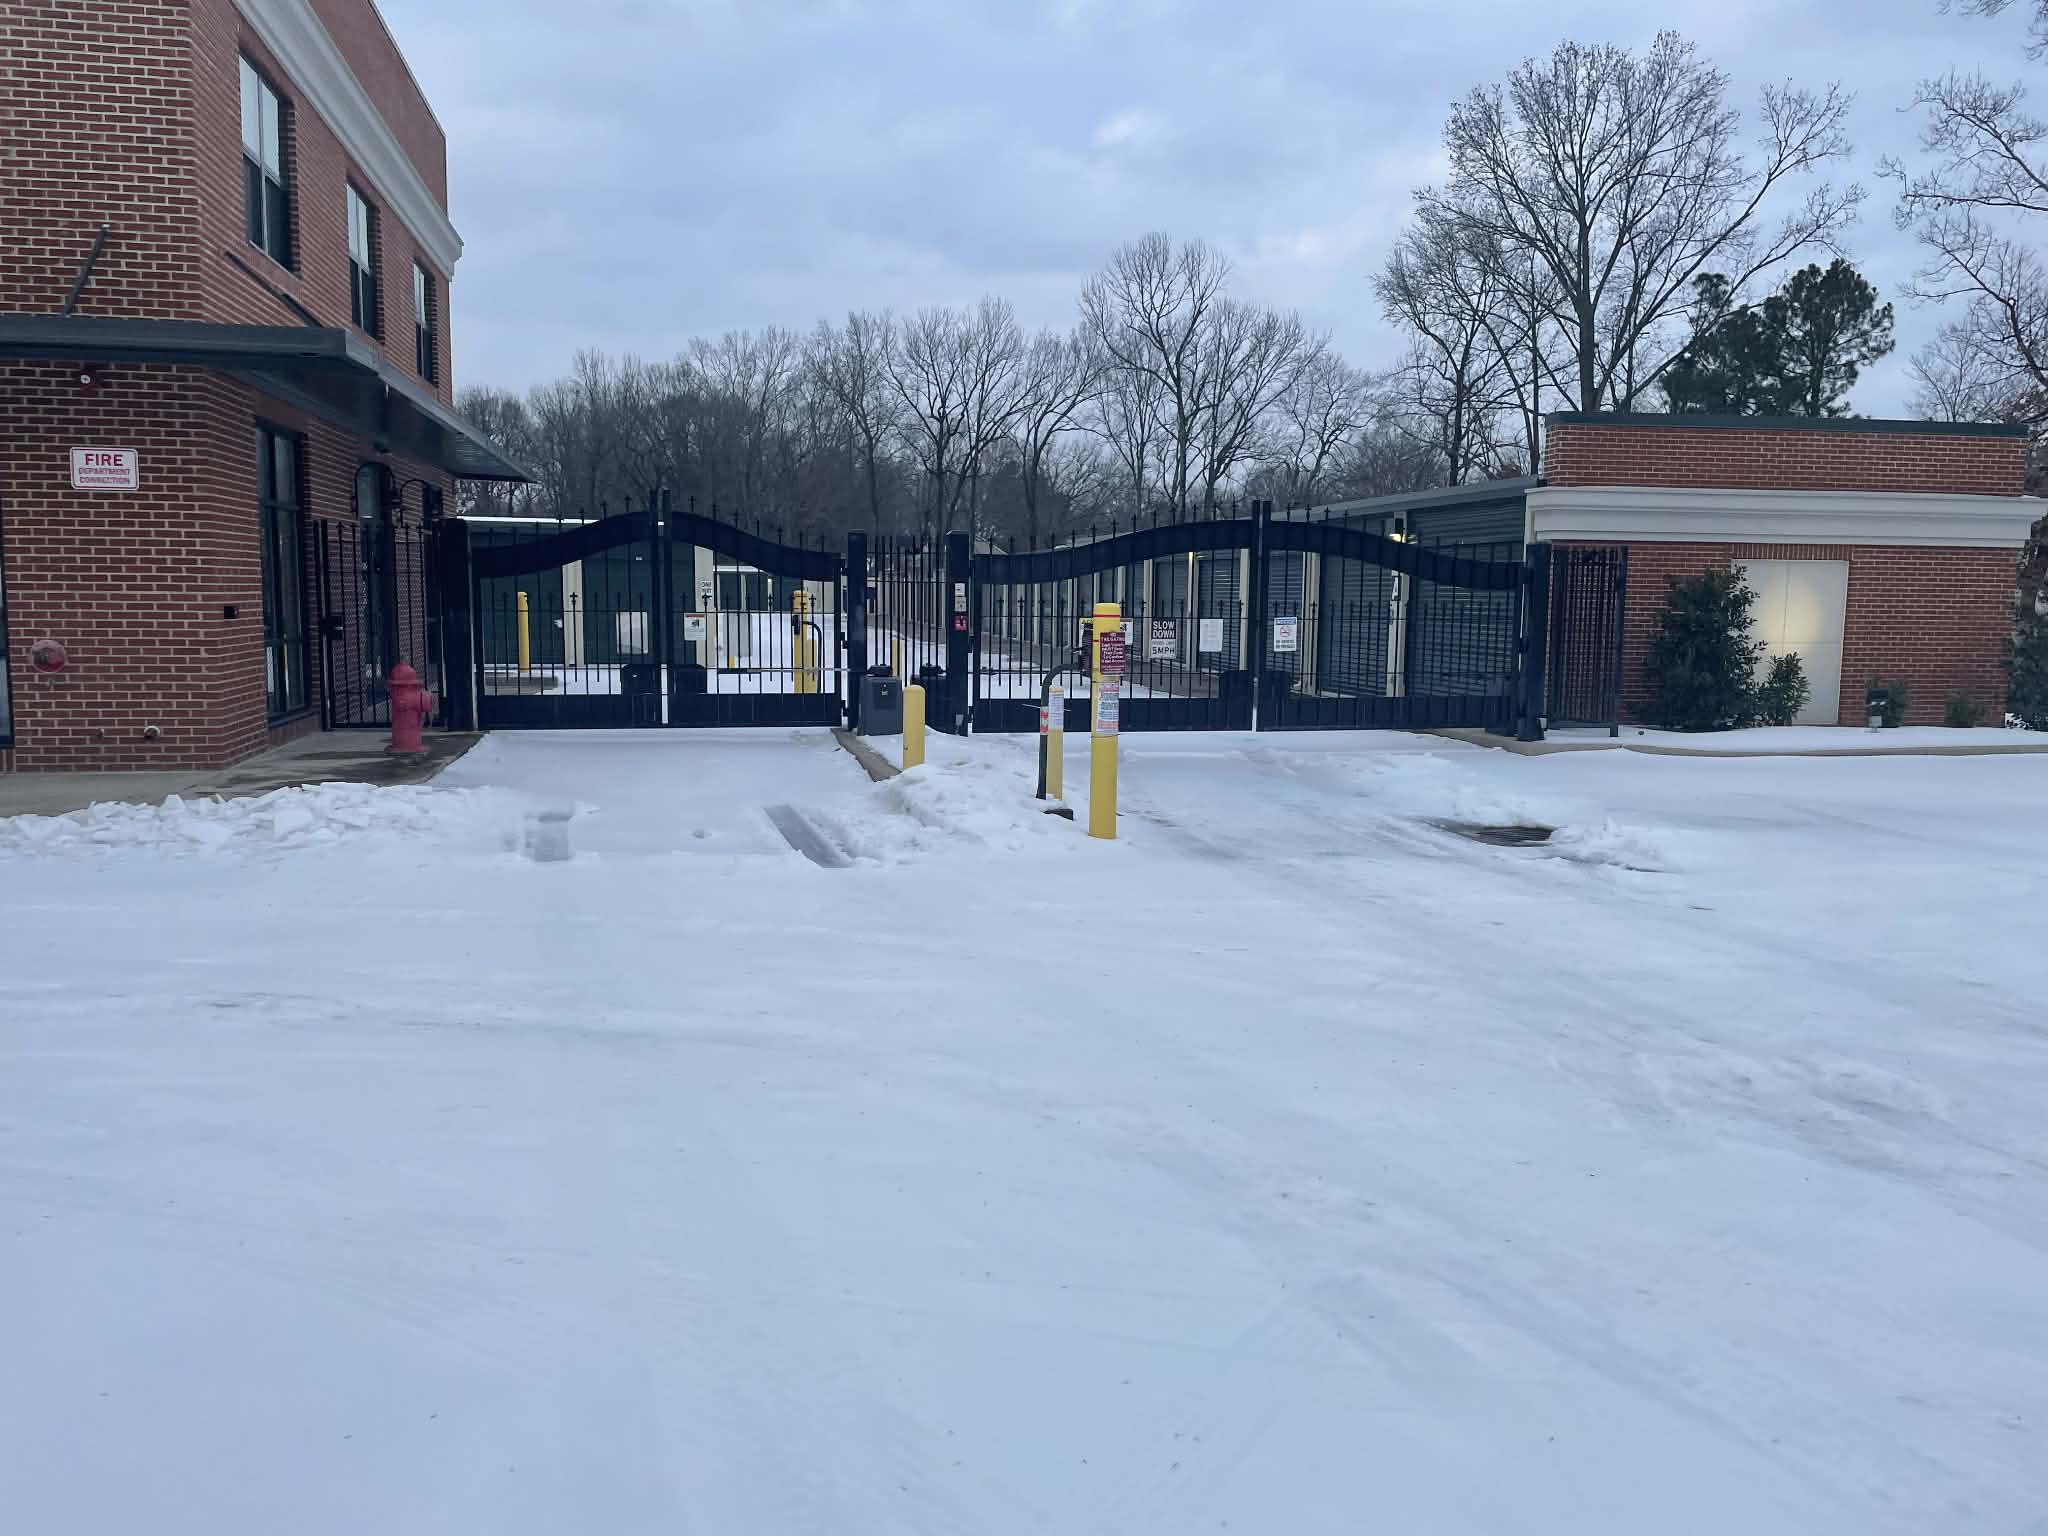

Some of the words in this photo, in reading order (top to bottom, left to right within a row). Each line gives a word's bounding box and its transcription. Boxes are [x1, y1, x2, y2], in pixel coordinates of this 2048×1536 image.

[85, 454, 123, 466] FIRE
[1153, 621, 1174, 629] SLOW
[1153, 630, 1174, 638] DOWN
